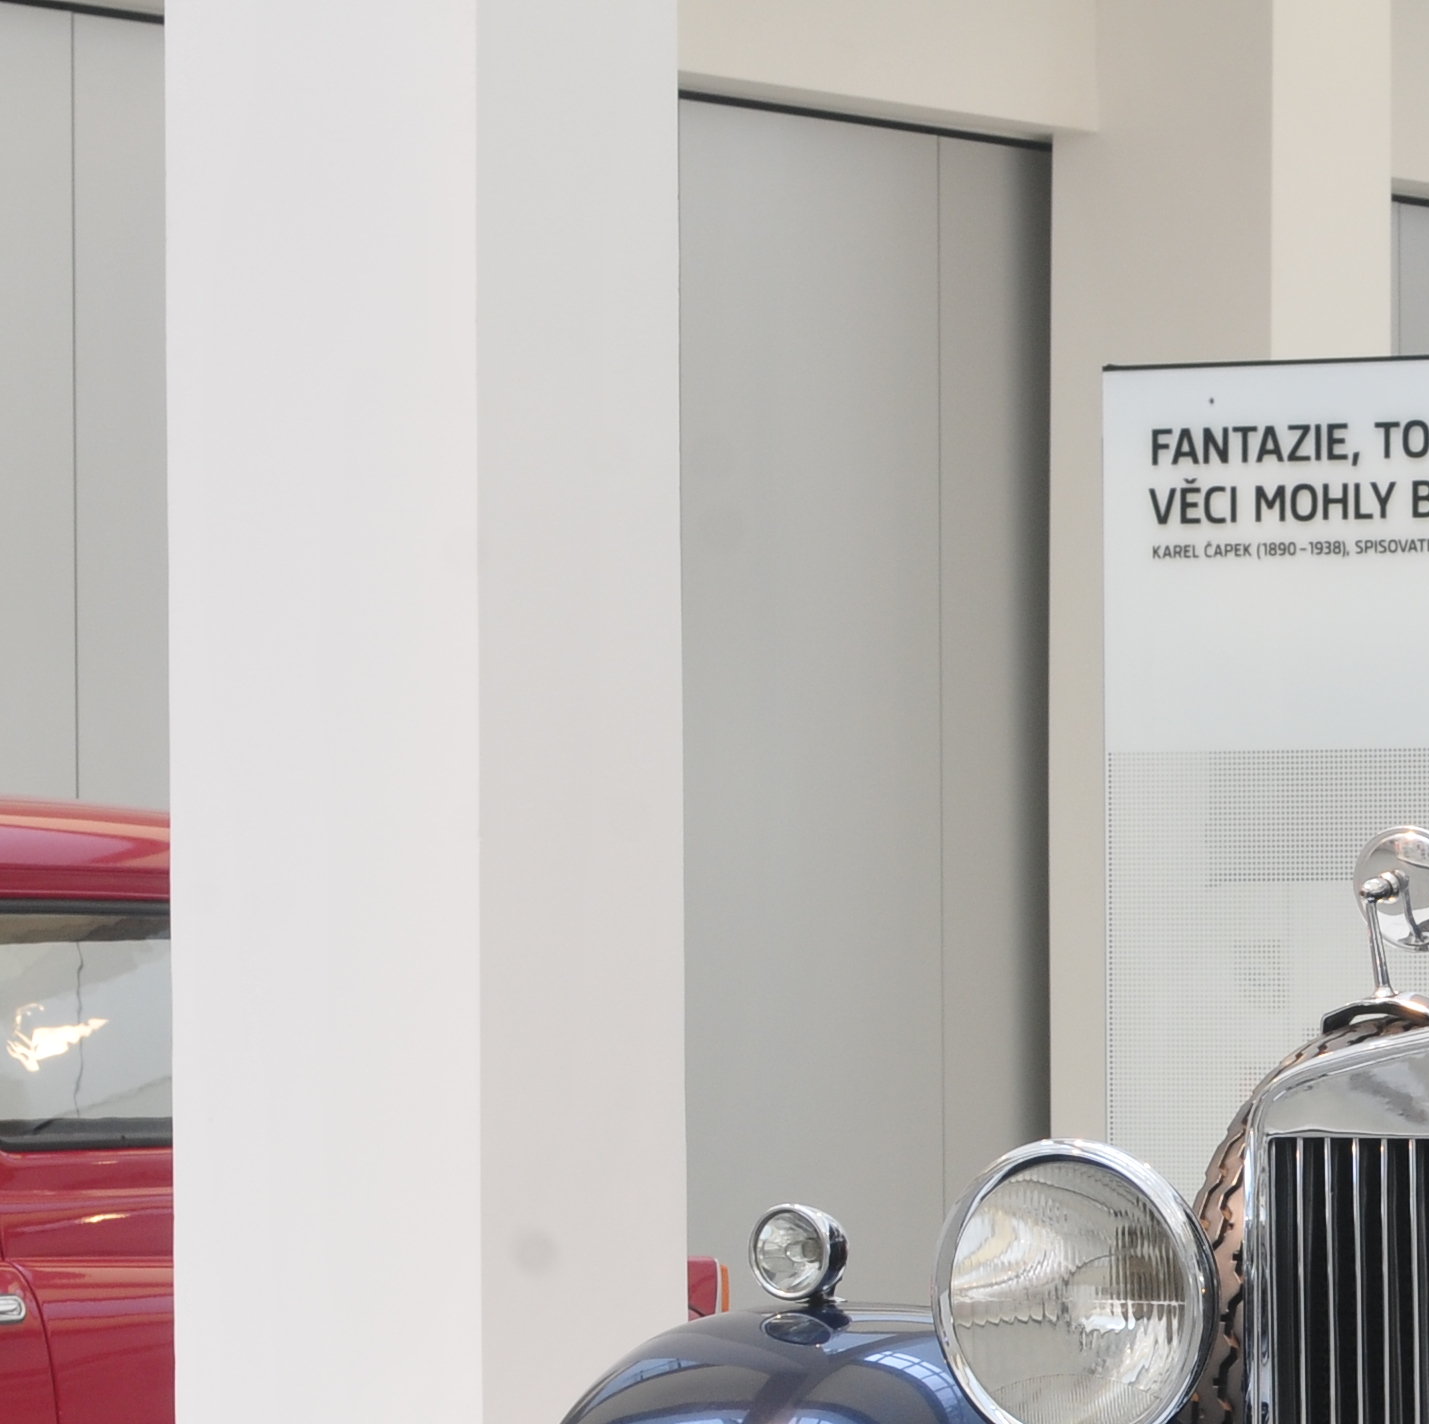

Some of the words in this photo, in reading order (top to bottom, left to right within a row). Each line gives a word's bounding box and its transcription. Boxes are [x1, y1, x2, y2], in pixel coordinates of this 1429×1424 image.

[1151, 423, 1360, 467] FANTAZIE,
[1148, 478, 1238, 525] VĚCI
[1254, 481, 1397, 523] MOHLY
[1152, 545, 1200, 560] KAREL
[1203, 540, 1252, 559] ČAPEK
